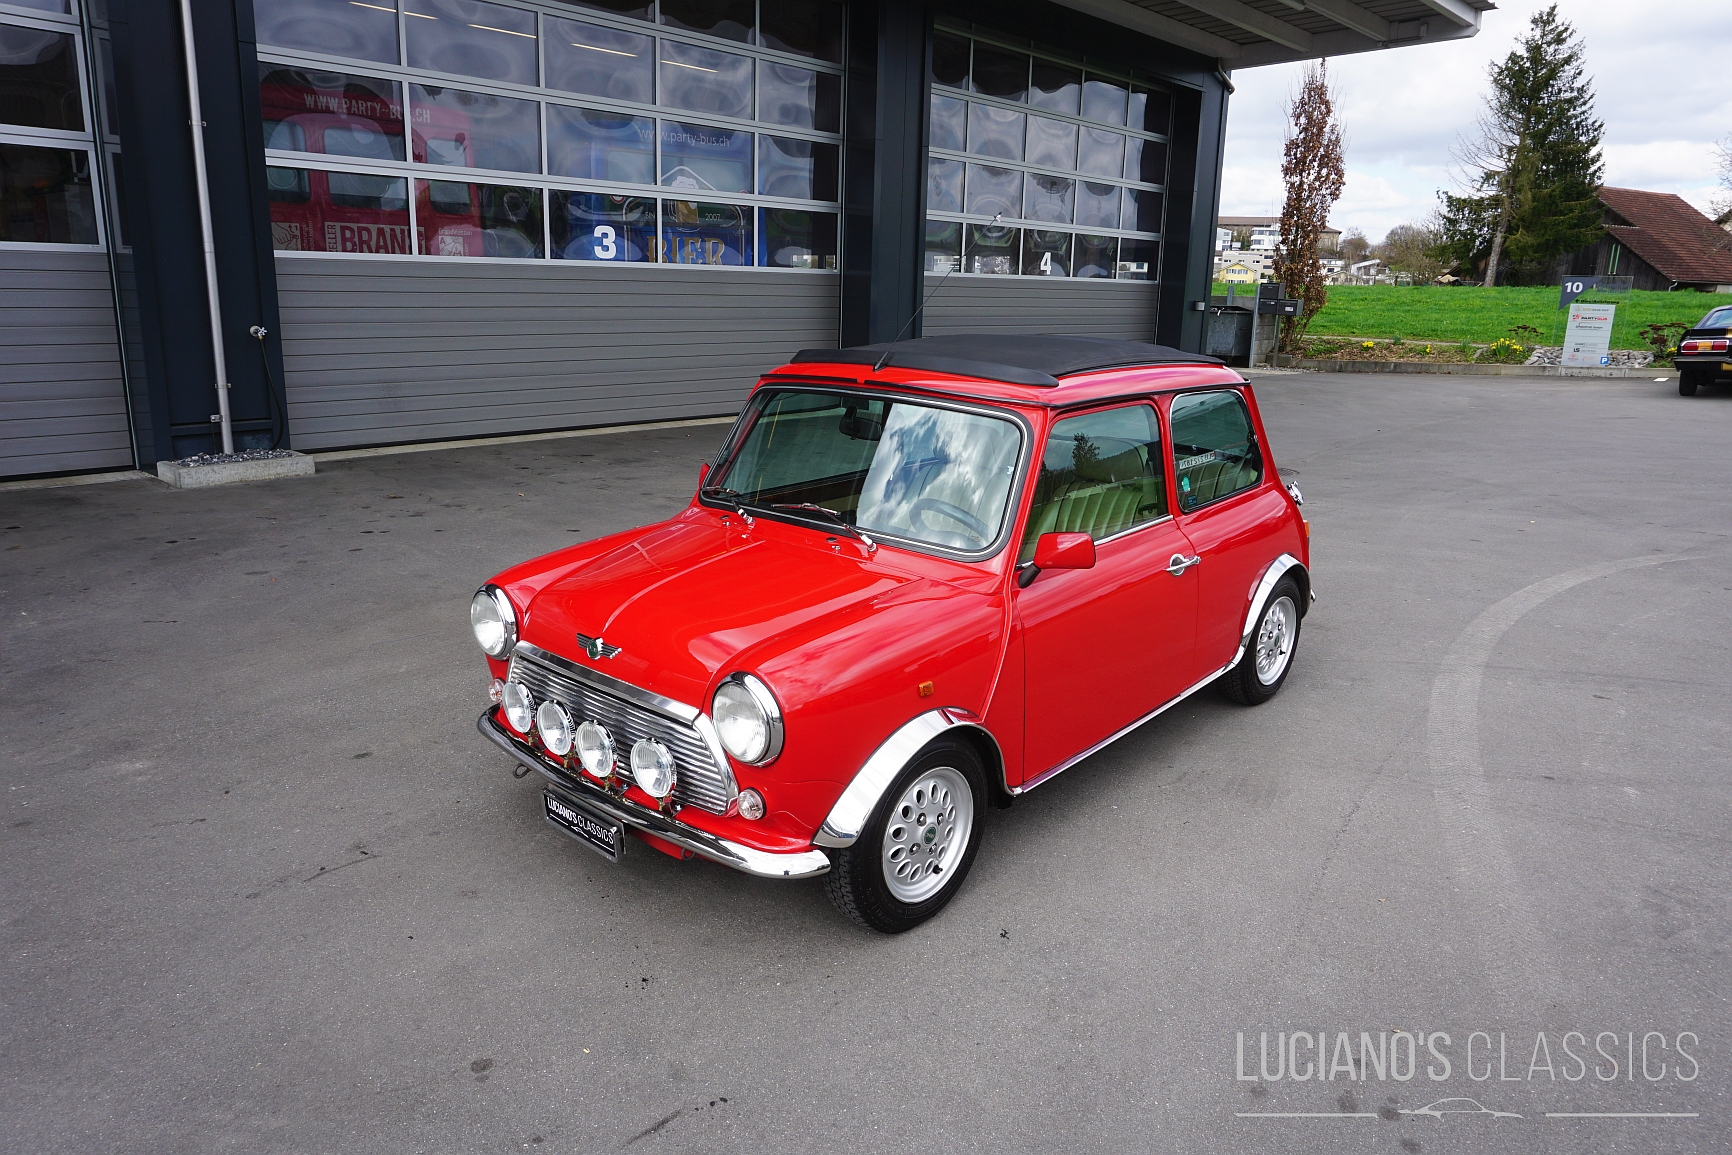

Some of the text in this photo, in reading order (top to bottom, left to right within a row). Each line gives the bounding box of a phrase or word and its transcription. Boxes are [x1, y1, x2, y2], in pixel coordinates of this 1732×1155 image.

[705, 213, 721, 221] 2007
[593, 225, 617, 259] 3
[1040, 251, 1052, 275] 4
[1565, 282, 1583, 293] 10
[547, 797, 614, 844] LUCIANO'S CLASSICS
